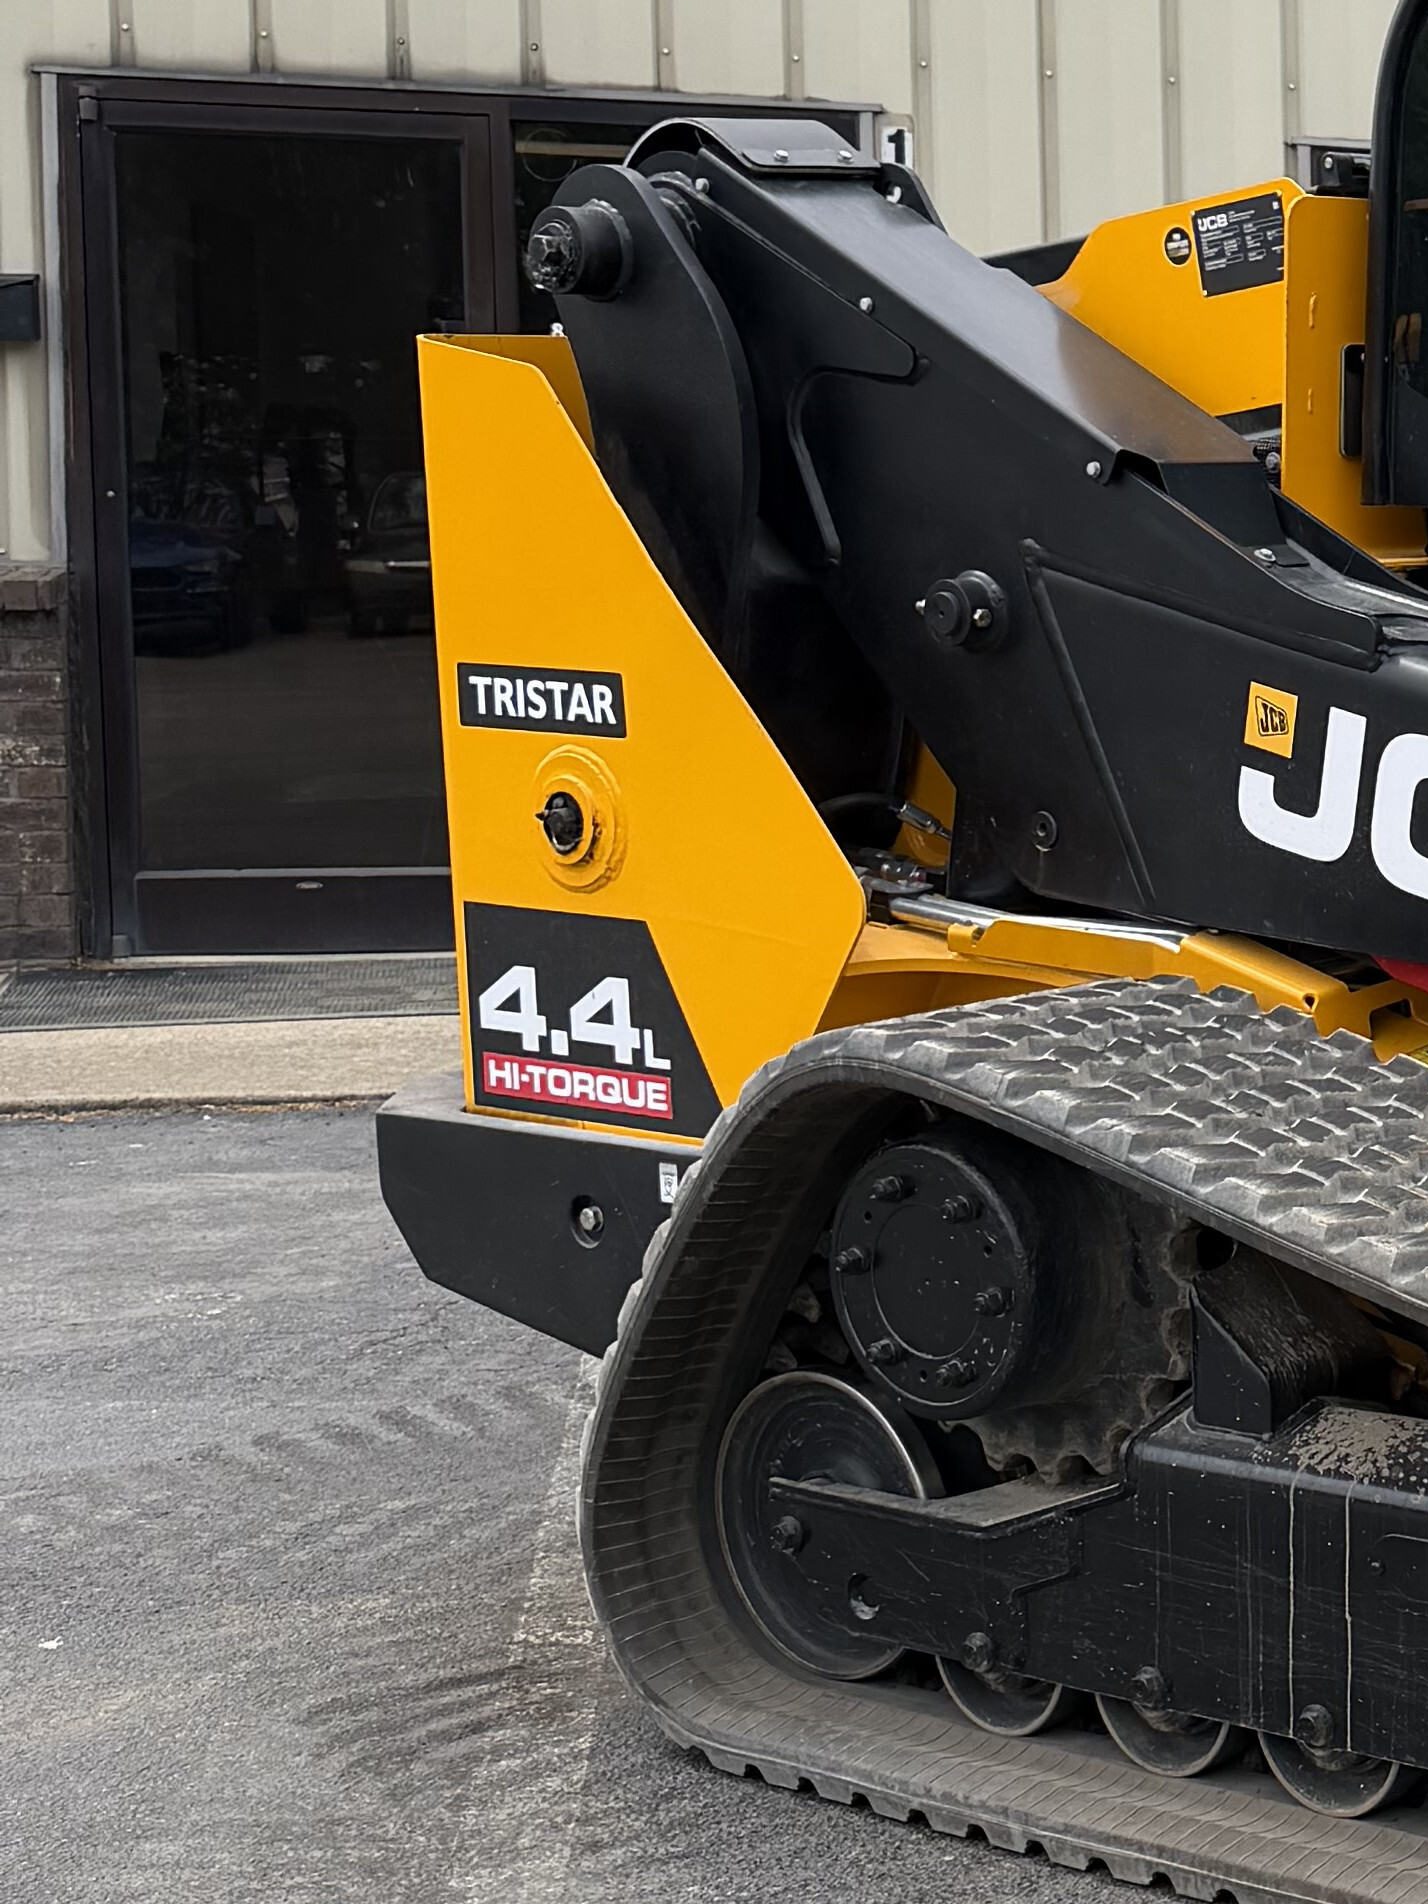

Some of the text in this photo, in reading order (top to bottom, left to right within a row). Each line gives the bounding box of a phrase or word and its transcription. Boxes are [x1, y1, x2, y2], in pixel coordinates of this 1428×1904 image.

[1197, 213, 1228, 232] JCB
[468, 675, 617, 725] TRISTAR
[1260, 701, 1287, 733] JCB
[478, 965, 671, 1070] 4.4L
[488, 1059, 668, 1112] HI-TORQUE
